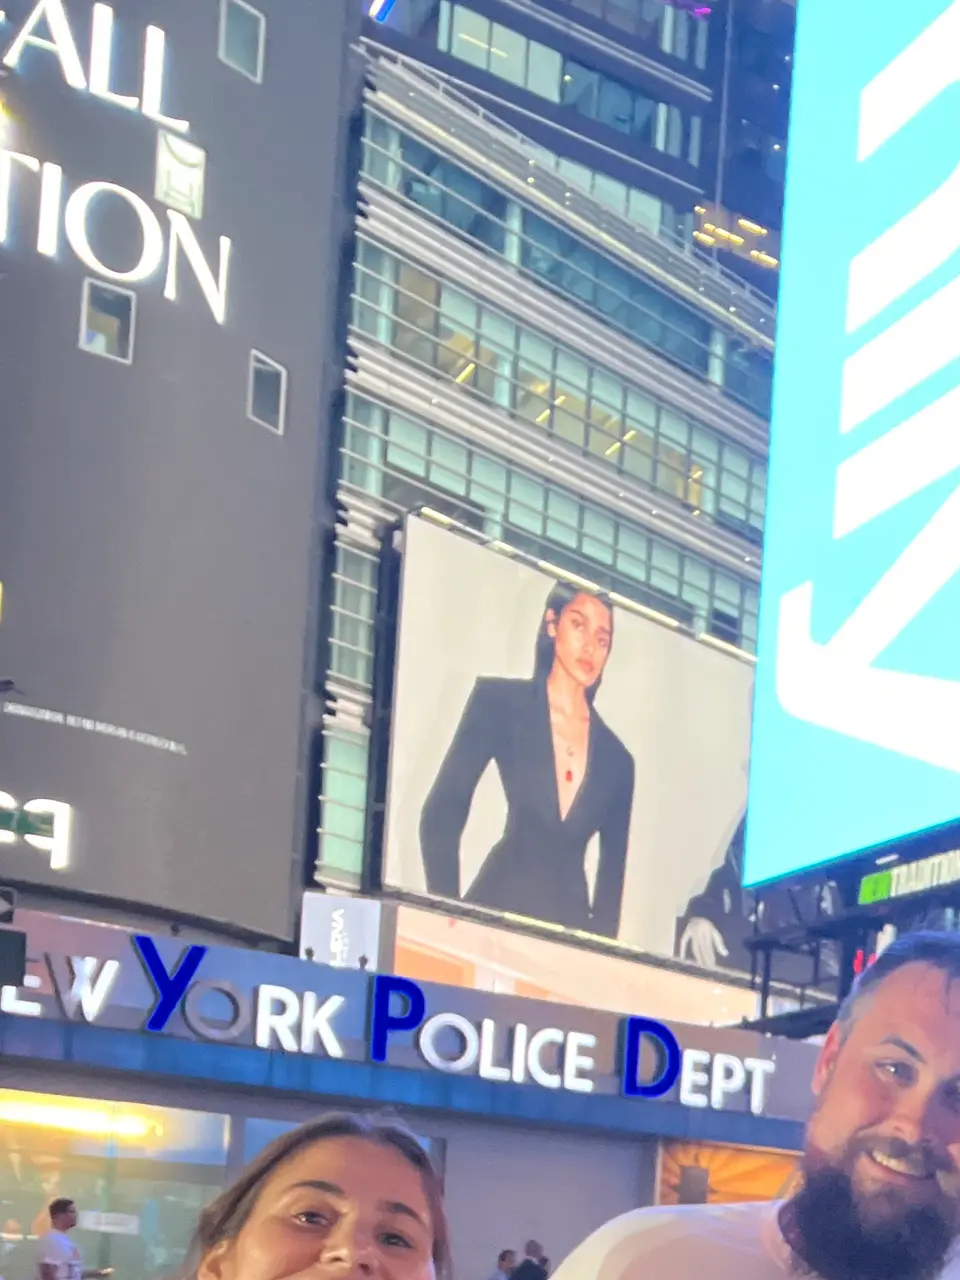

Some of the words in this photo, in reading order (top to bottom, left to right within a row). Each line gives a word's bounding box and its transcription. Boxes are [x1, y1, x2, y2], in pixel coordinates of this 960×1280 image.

[0, 0, 190, 132] ALL
[134, 934, 347, 1059] YORK
[370, 974, 597, 1093] POLICE
[623, 1015, 776, 1115] DEPT
